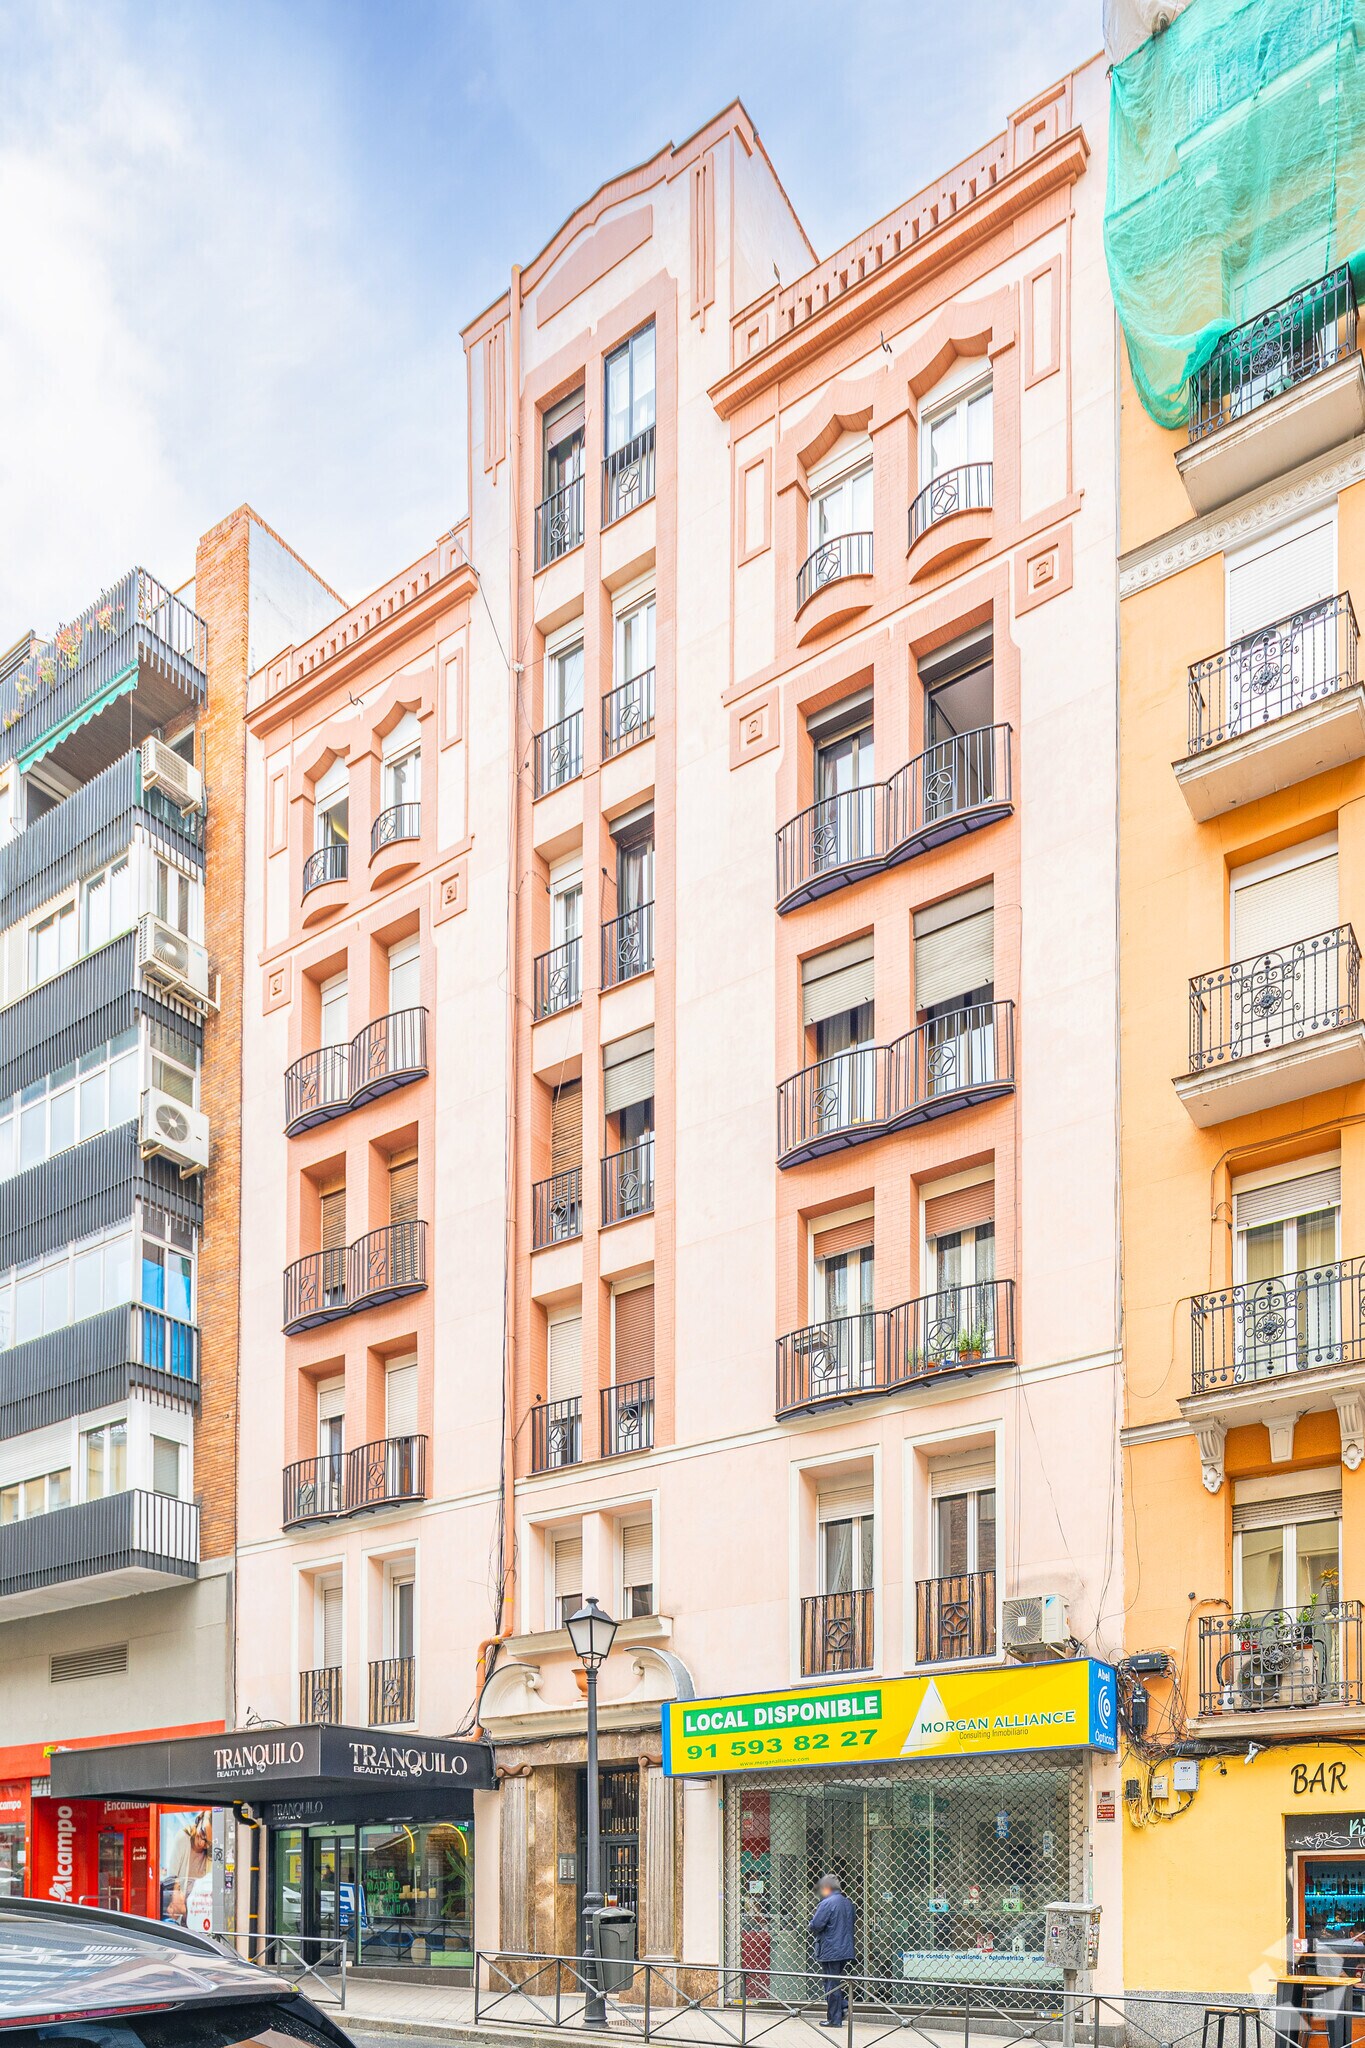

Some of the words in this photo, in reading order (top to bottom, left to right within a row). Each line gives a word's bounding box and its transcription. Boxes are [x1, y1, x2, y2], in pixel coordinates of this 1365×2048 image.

[1097, 1667, 1111, 1683] Abel
[686, 1710, 749, 1732] LOCAL
[754, 1696, 878, 1726] DISPONIBLE
[921, 1718, 988, 1734] MORGAN
[993, 1710, 1075, 1728] ALLIANCE
[959, 1731, 991, 1740] Consulting
[992, 1727, 1029, 1737] Inmobiliario
[687, 1743, 717, 1760] 91
[730, 1738, 783, 1756] 593
[793, 1733, 830, 1751] 82
[841, 1729, 878, 1747] 27
[213, 1741, 304, 1773] TRANQUILO
[348, 1742, 468, 1777] TRANQUILO
[740, 1757, 810, 1766] www.morganalliance.com
[216, 1769, 241, 1778] BEAUTY
[241, 1768, 255, 1776] LAB
[353, 1765, 389, 1776] BEAUTY
[390, 1768, 408, 1778] LAB
[1290, 1761, 1348, 1794] BAR
[271, 1801, 323, 1819] TRANQUILO
[49, 1805, 77, 1903] Alcampo
[366, 1868, 395, 1880] HELLO
